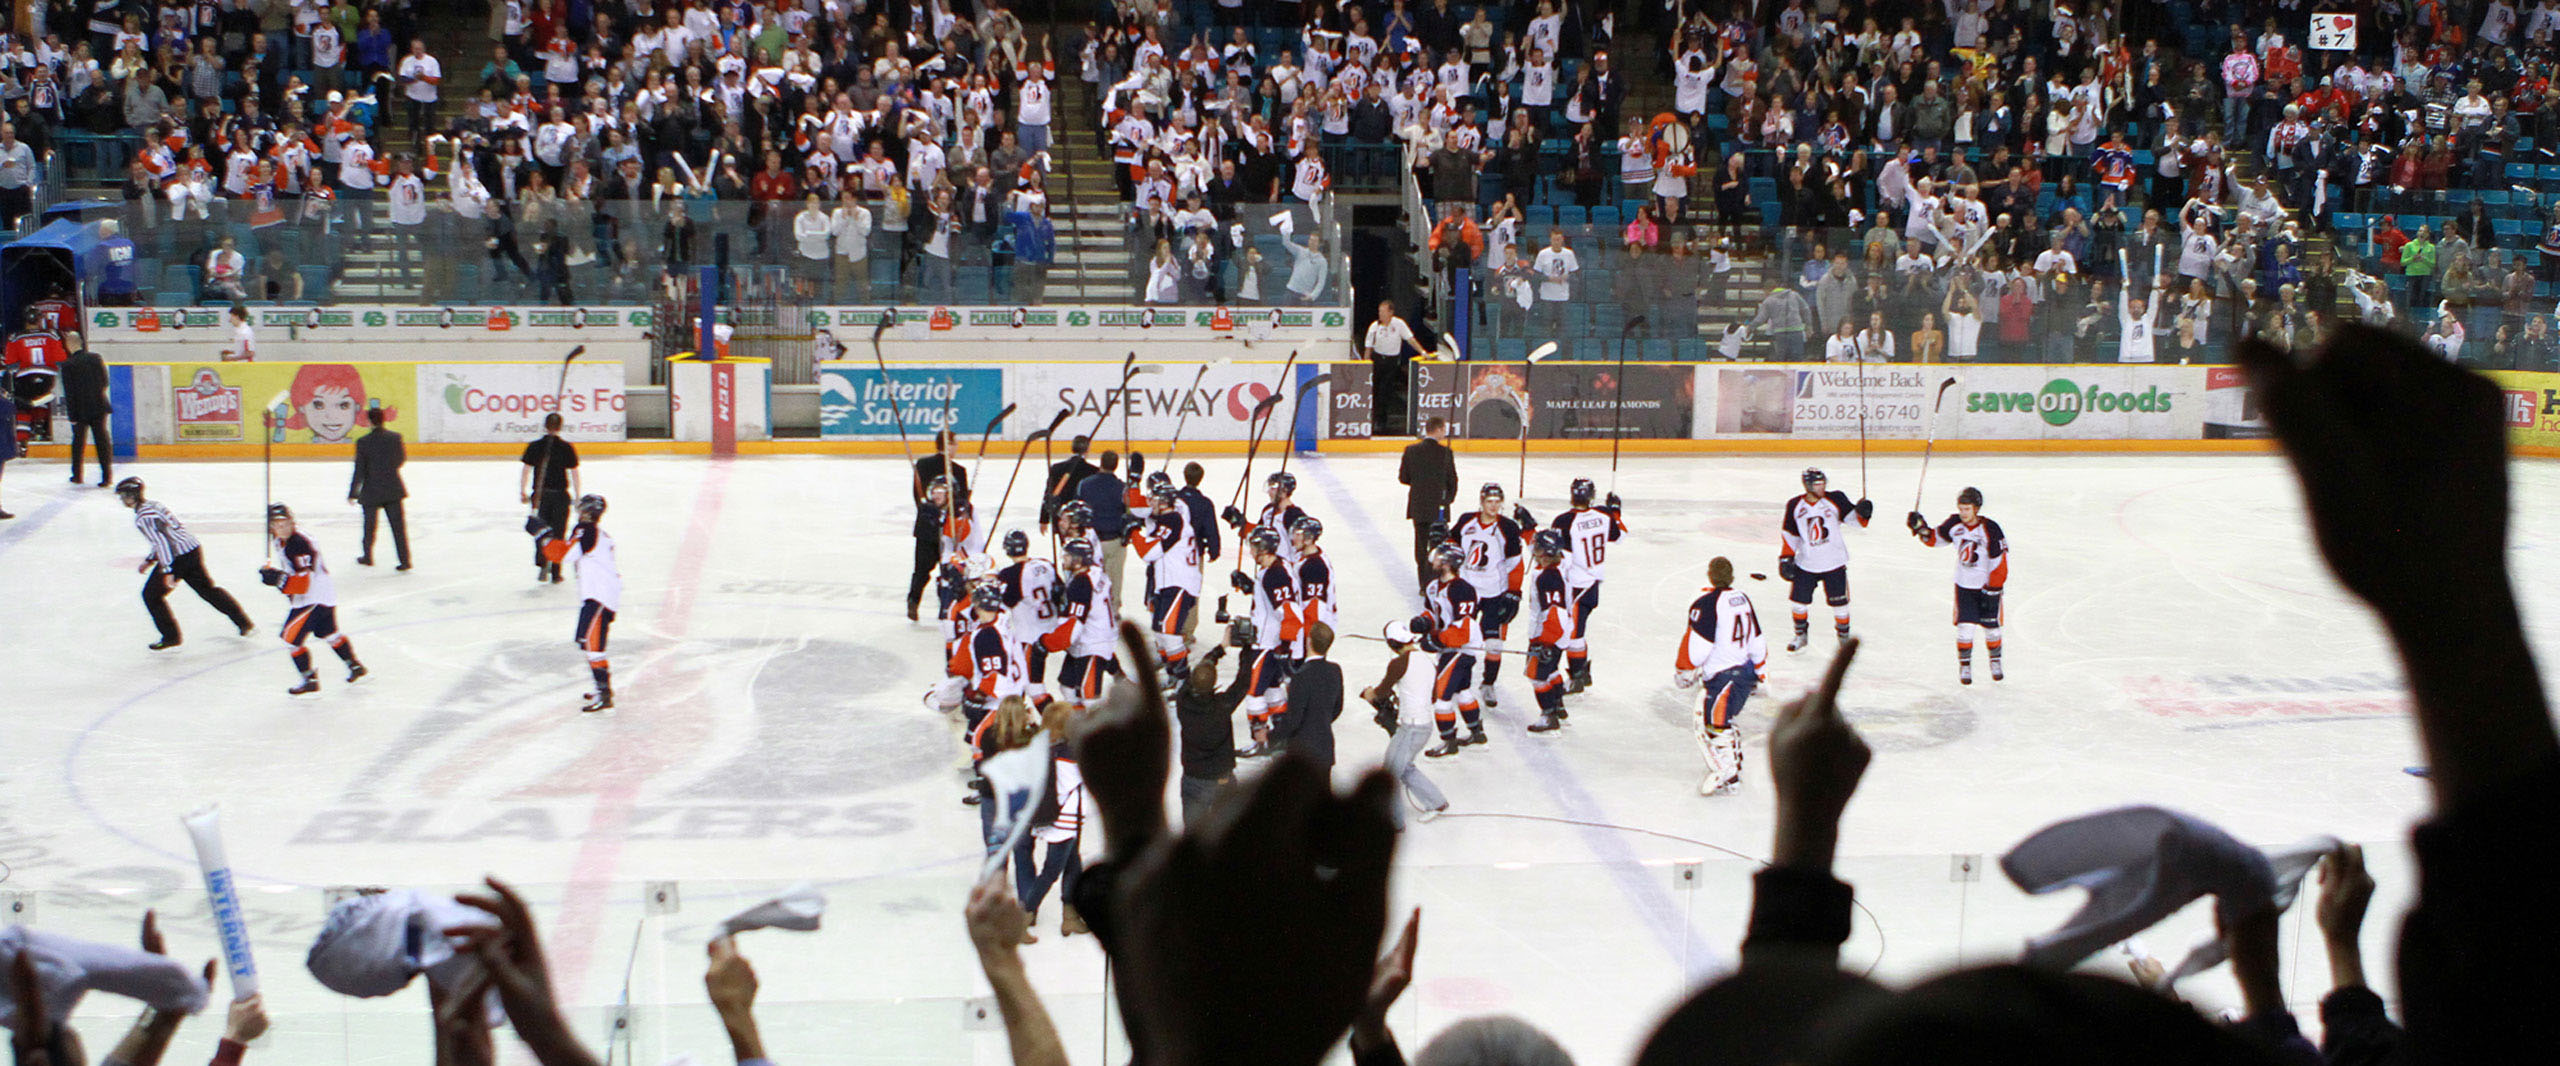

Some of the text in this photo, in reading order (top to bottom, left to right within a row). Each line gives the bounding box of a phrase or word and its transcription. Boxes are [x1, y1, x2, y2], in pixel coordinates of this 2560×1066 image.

[863, 377, 963, 402] Interior
[1818, 371, 1925, 388] Welcome Back
[179, 390, 238, 420] Wendy's
[464, 388, 586, 419] Cooper's
[718, 371, 730, 422] CCM
[1058, 387, 1224, 417] SAFEWAY
[1418, 393, 1463, 408] UEEN
[1546, 400, 1661, 409] MAPLE LEAF DAMONDS
[860, 401, 960, 432] Savings
[1795, 404, 1920, 420] 250.823.6740
[1580, 533, 1605, 569] 18
[1273, 586, 1292, 601] 22
[1307, 583, 1324, 597] 32
[1070, 601, 1085, 617] 10
[1459, 601, 1476, 615] 27
[982, 655, 1002, 672] 39
[285, 802, 918, 845] BLAZERS
[208, 867, 252, 977] INTERNET
